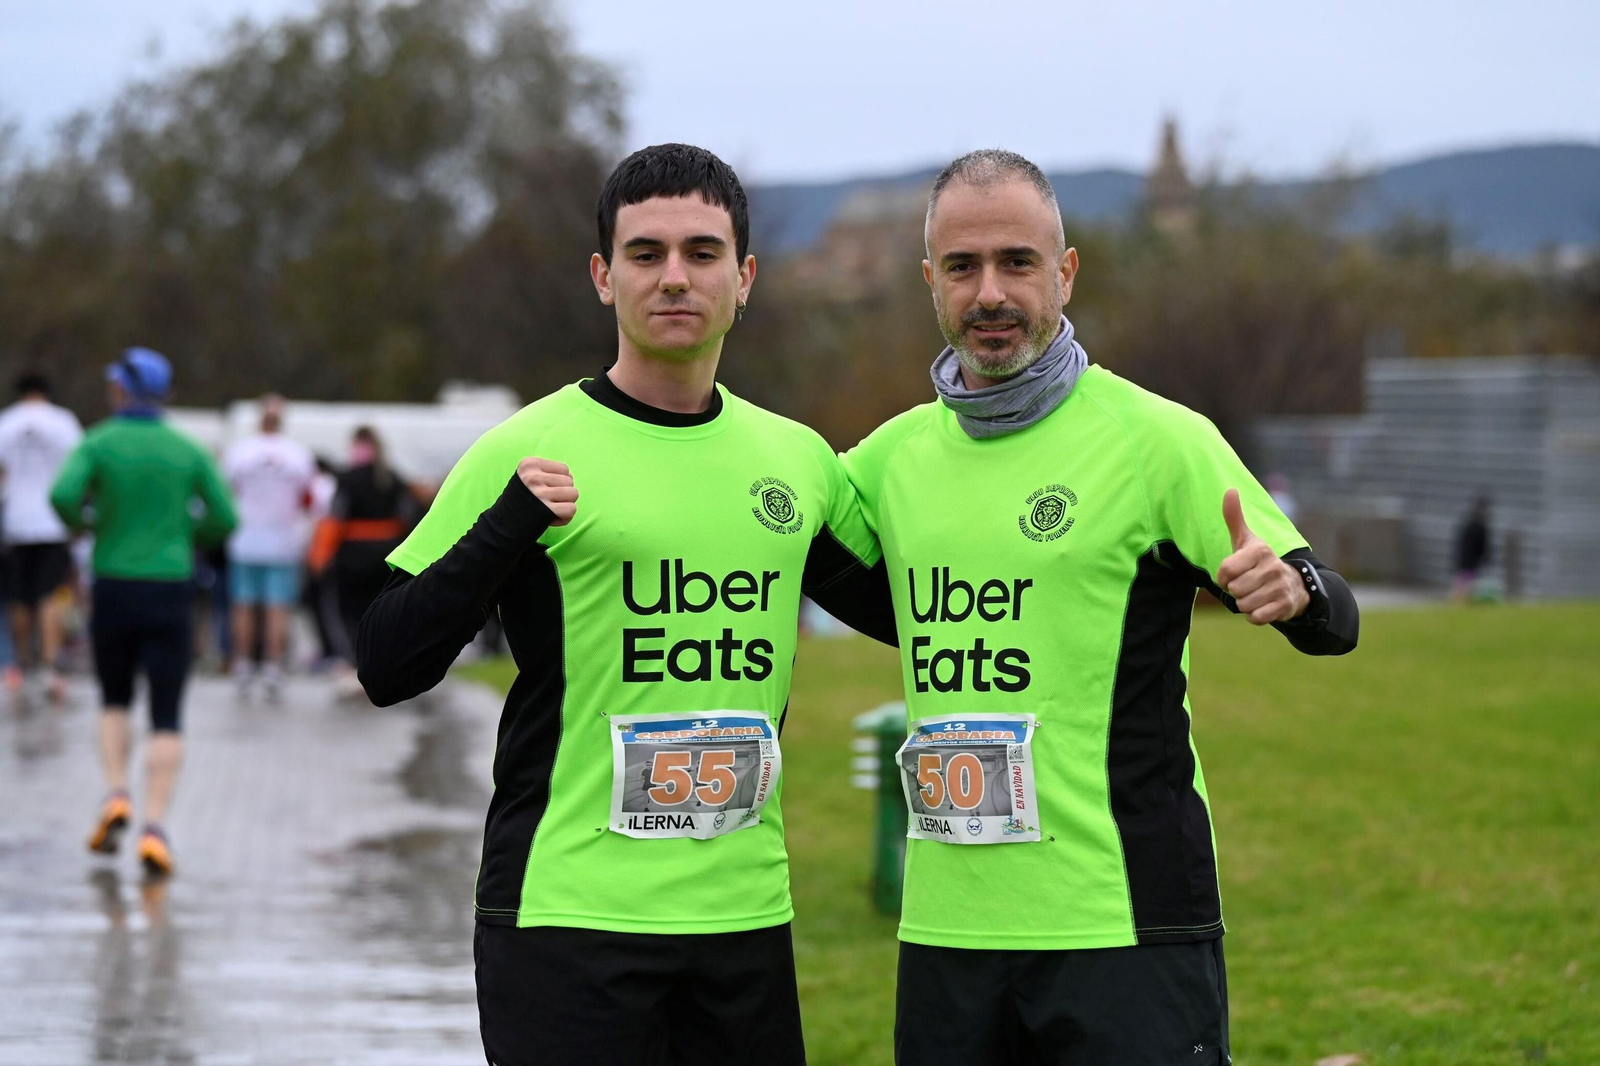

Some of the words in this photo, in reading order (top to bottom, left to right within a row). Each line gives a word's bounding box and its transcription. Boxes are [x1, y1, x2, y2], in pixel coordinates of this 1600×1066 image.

[1025, 488, 1044, 505] CLUB
[623, 559, 780, 616] Uber
[908, 567, 1033, 623] Uber
[623, 628, 774, 682] Eats
[912, 636, 1031, 692] Eats
[692, 720, 718, 728] 12
[648, 750, 737, 806] 55
[758, 792, 765, 802] EN
[759, 761, 771, 792] NAVIDAD
[917, 753, 984, 810] 50
[1013, 766, 1024, 799] NAVIDAD
[1016, 799, 1025, 810] EN
